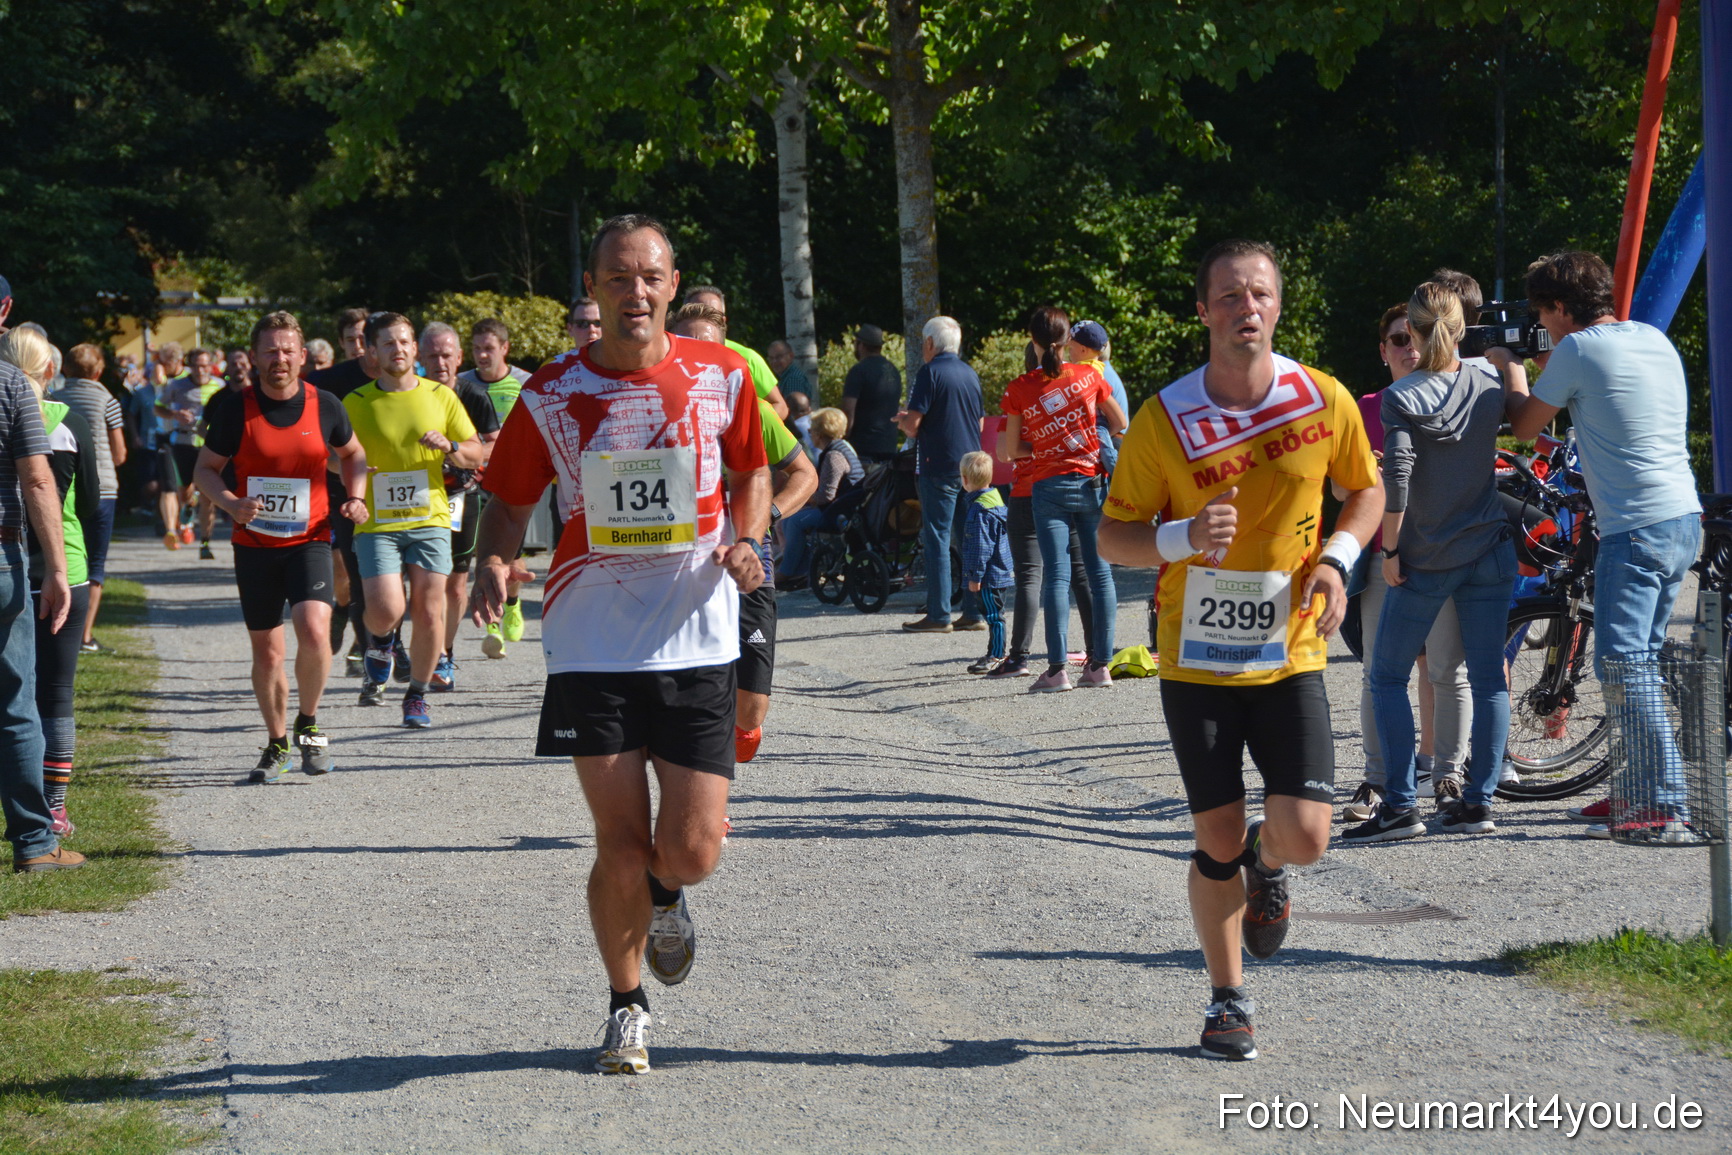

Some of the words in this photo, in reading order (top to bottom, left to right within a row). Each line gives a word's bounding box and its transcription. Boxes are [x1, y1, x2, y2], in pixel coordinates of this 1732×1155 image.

[1192, 449, 1259, 490] MAX
[1263, 421, 1334, 462] BÖGL
[612, 458, 662, 472] BOCK
[387, 486, 416, 502] 137
[610, 478, 670, 512] 134
[264, 522, 288, 531] Oliver
[612, 528, 672, 543] Bernhard
[1215, 579, 1263, 592] BOCK
[1198, 597, 1276, 630] 2399
[1204, 632, 1226, 640] PARTL
[1206, 646, 1262, 660] Christian
